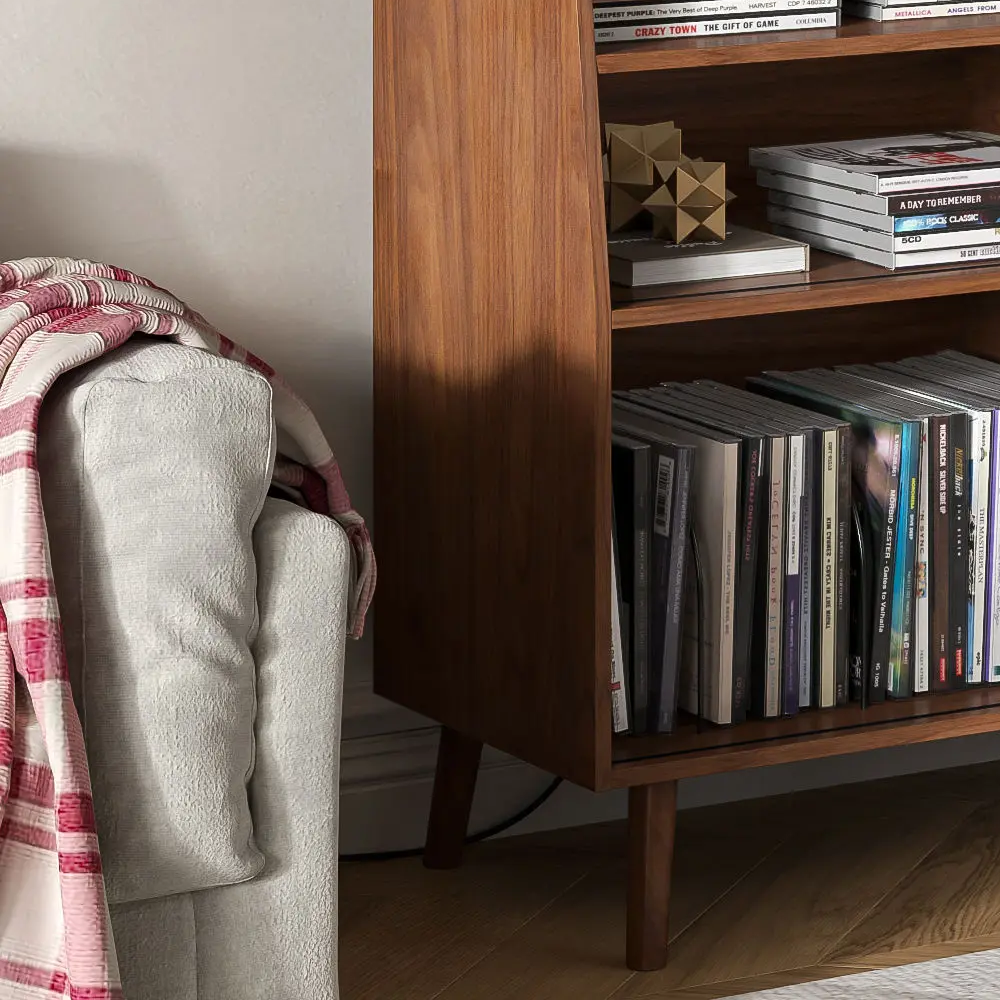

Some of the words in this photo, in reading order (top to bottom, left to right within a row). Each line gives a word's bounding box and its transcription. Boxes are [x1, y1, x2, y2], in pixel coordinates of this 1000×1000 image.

[594, 9, 625, 18] DEEPEST
[669, 7, 681, 16] Very
[683, 6, 696, 14] Best
[697, 5, 703, 13] of
[704, 4, 718, 14] Deep
[720, 4, 738, 13] Purple
[895, 9, 932, 18] METALLICA
[948, 5, 974, 14] ANGELS
[795, 17, 827, 25] COLUMBIA
[635, 27, 665, 37] CRAZY
[670, 25, 697, 34] TOWN
[704, 23, 719, 31] THE
[722, 22, 741, 30] GIFT
[743, 21, 754, 29] OF
[757, 20, 779, 28] GAME
[908, 200, 925, 209] DAY
[927, 199, 936, 207] TO
[937, 195, 981, 206] REMEMBER
[926, 217, 947, 225] ROCK
[949, 214, 978, 223] CLASSIC
[886, 489, 897, 524] MORBID
[939, 506, 946, 514] UP
[884, 526, 894, 559] JESTER
[977, 526, 985, 584] MASTERPLAN
[882, 566, 890, 590] Gates
[881, 592, 888, 600] to
[878, 601, 888, 633] Valhalla
